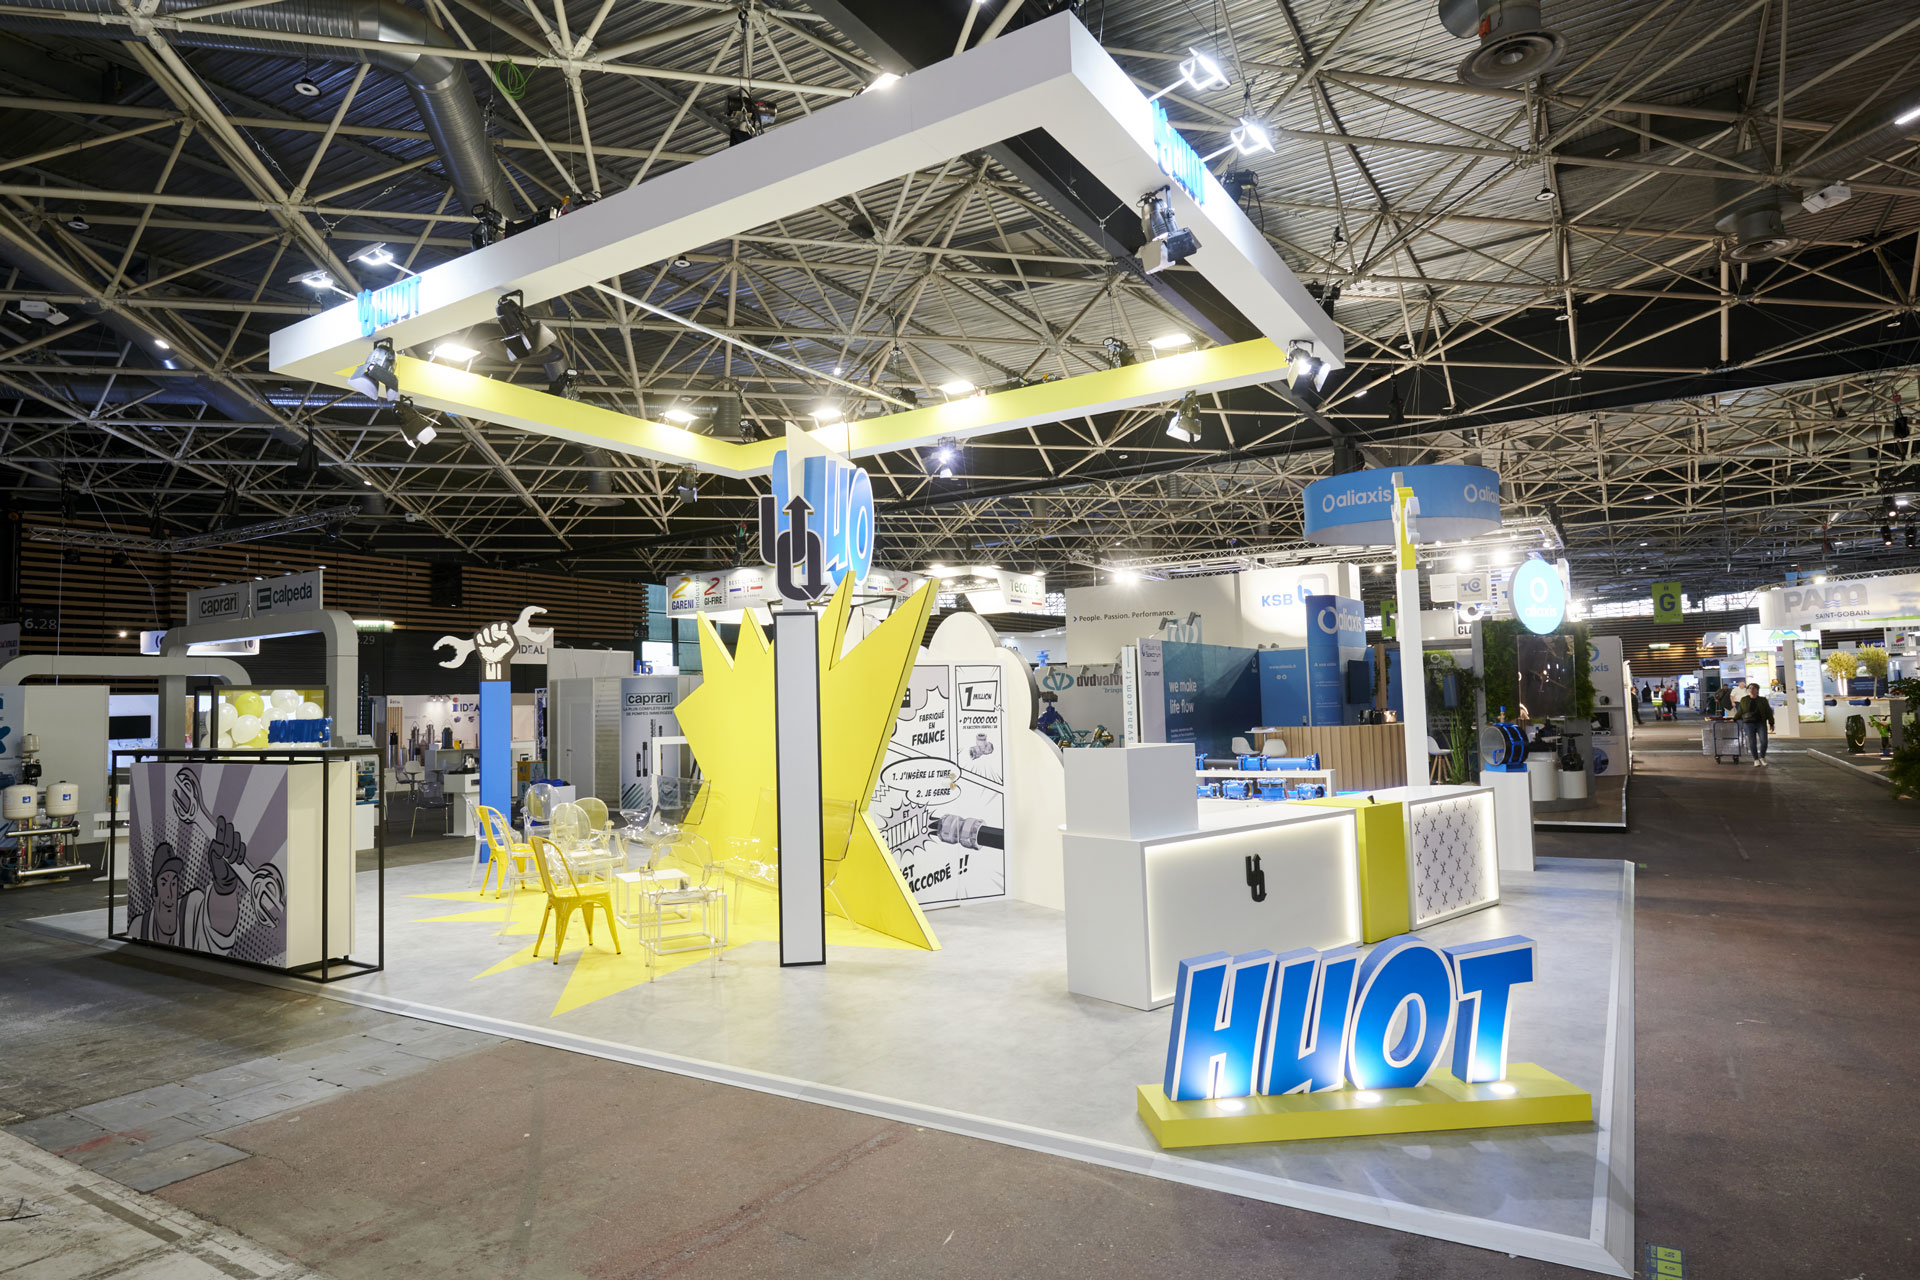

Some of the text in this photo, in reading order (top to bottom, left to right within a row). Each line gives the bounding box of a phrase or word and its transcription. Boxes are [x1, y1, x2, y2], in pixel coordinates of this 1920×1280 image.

[376, 275, 422, 328] HUOT
[1336, 486, 1391, 507] aliaxis
[273, 583, 313, 604] calpeda
[201, 593, 237, 616] caprari
[672, 599, 694, 611] GARENI
[1261, 594, 1293, 607] KSB
[1659, 593, 1676, 612] G
[1079, 610, 1176, 622] People. Passion. Performance.
[1339, 608, 1362, 632] aliaxis
[1815, 610, 1870, 619] SAINT-GOBAIN
[24, 618, 57, 630] 6.28
[360, 634, 376, 645] .29
[518, 644, 545, 654] IDEAL
[1077, 673, 1122, 687] dvdvalv
[1169, 679, 1197, 692] we make
[628, 692, 671, 705] caprari
[965, 686, 974, 707] 1
[460, 703, 480, 712] IDEA
[1169, 699, 1194, 714] life flow
[919, 710, 945, 722] FABRIQUÉ
[912, 730, 945, 746] FRANCE
[893, 772, 898, 780] 1.
[900, 769, 926, 780] J'INSÈRE
[928, 770, 935, 778] LE
[925, 788, 931, 797] JE
[933, 788, 951, 796] SERRE
[903, 809, 910, 819] ET
[902, 864, 914, 880] ST
[1164, 935, 1537, 1102] HUOT
